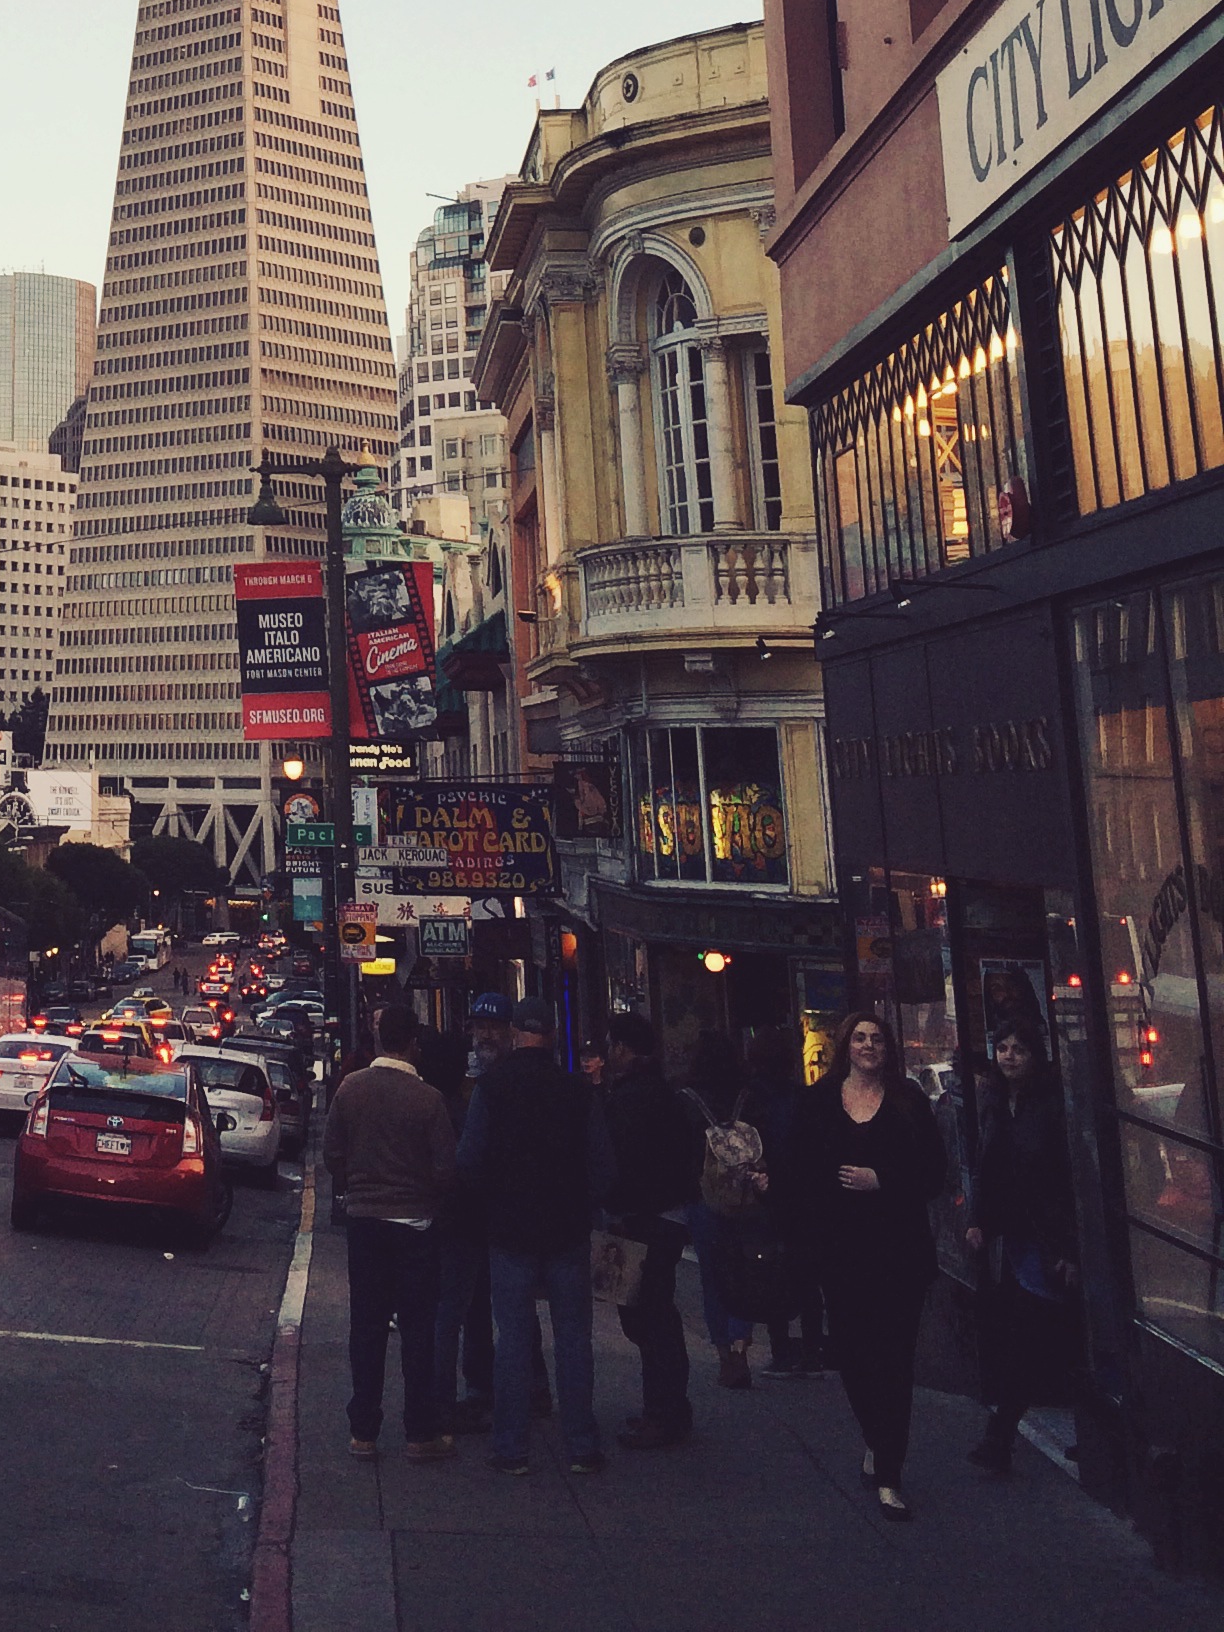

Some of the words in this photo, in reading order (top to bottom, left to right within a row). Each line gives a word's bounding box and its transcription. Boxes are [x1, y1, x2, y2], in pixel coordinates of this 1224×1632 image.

[244, 576, 278, 587] THROUGH
[279, 575, 306, 585] MARCH
[258, 612, 303, 629] MUSEO
[264, 630, 300, 646] ITALO
[367, 628, 399, 639] ITALIAN
[368, 632, 410, 646] AMERICAN
[246, 646, 321, 665] AMERICANO
[366, 638, 418, 674] Cinema
[246, 669, 264, 679] FORT
[266, 668, 293, 678] MASON
[294, 667, 323, 677] CENTER
[249, 708, 325, 725] SFMUSEO.ORG
[349, 744, 380, 755] randy
[349, 757, 378, 768] unan
[379, 756, 411, 770] Food
[437, 791, 508, 805] PSYCHIC
[415, 807, 494, 828] PALM
[511, 808, 532, 828] &
[297, 829, 364, 841] Pacic
[482, 830, 548, 853] CARD
[361, 848, 388, 861] JACK
[398, 849, 445, 862] KEROUAC
[427, 871, 526, 888] 986.9320
[423, 922, 466, 941] ATM
